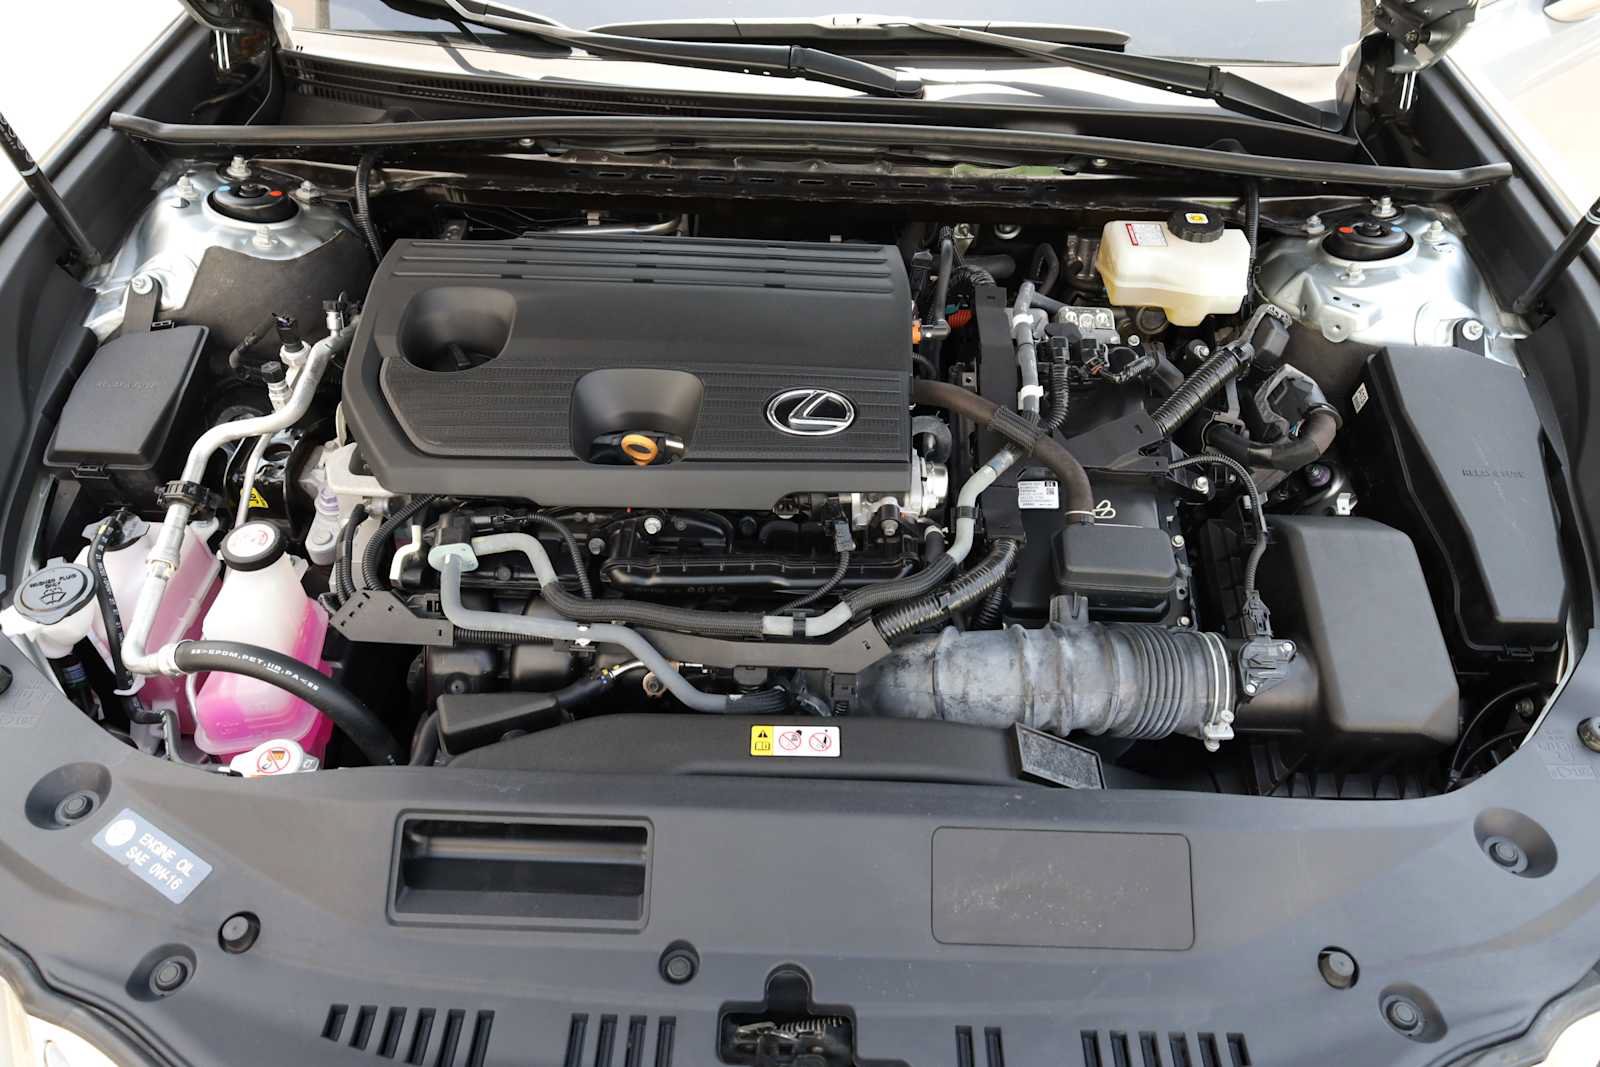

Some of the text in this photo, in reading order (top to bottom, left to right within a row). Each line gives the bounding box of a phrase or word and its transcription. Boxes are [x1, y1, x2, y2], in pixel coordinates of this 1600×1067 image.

[126, 846, 183, 890] SAE 0W-16
[139, 833, 194, 877] ENGINE OIL
